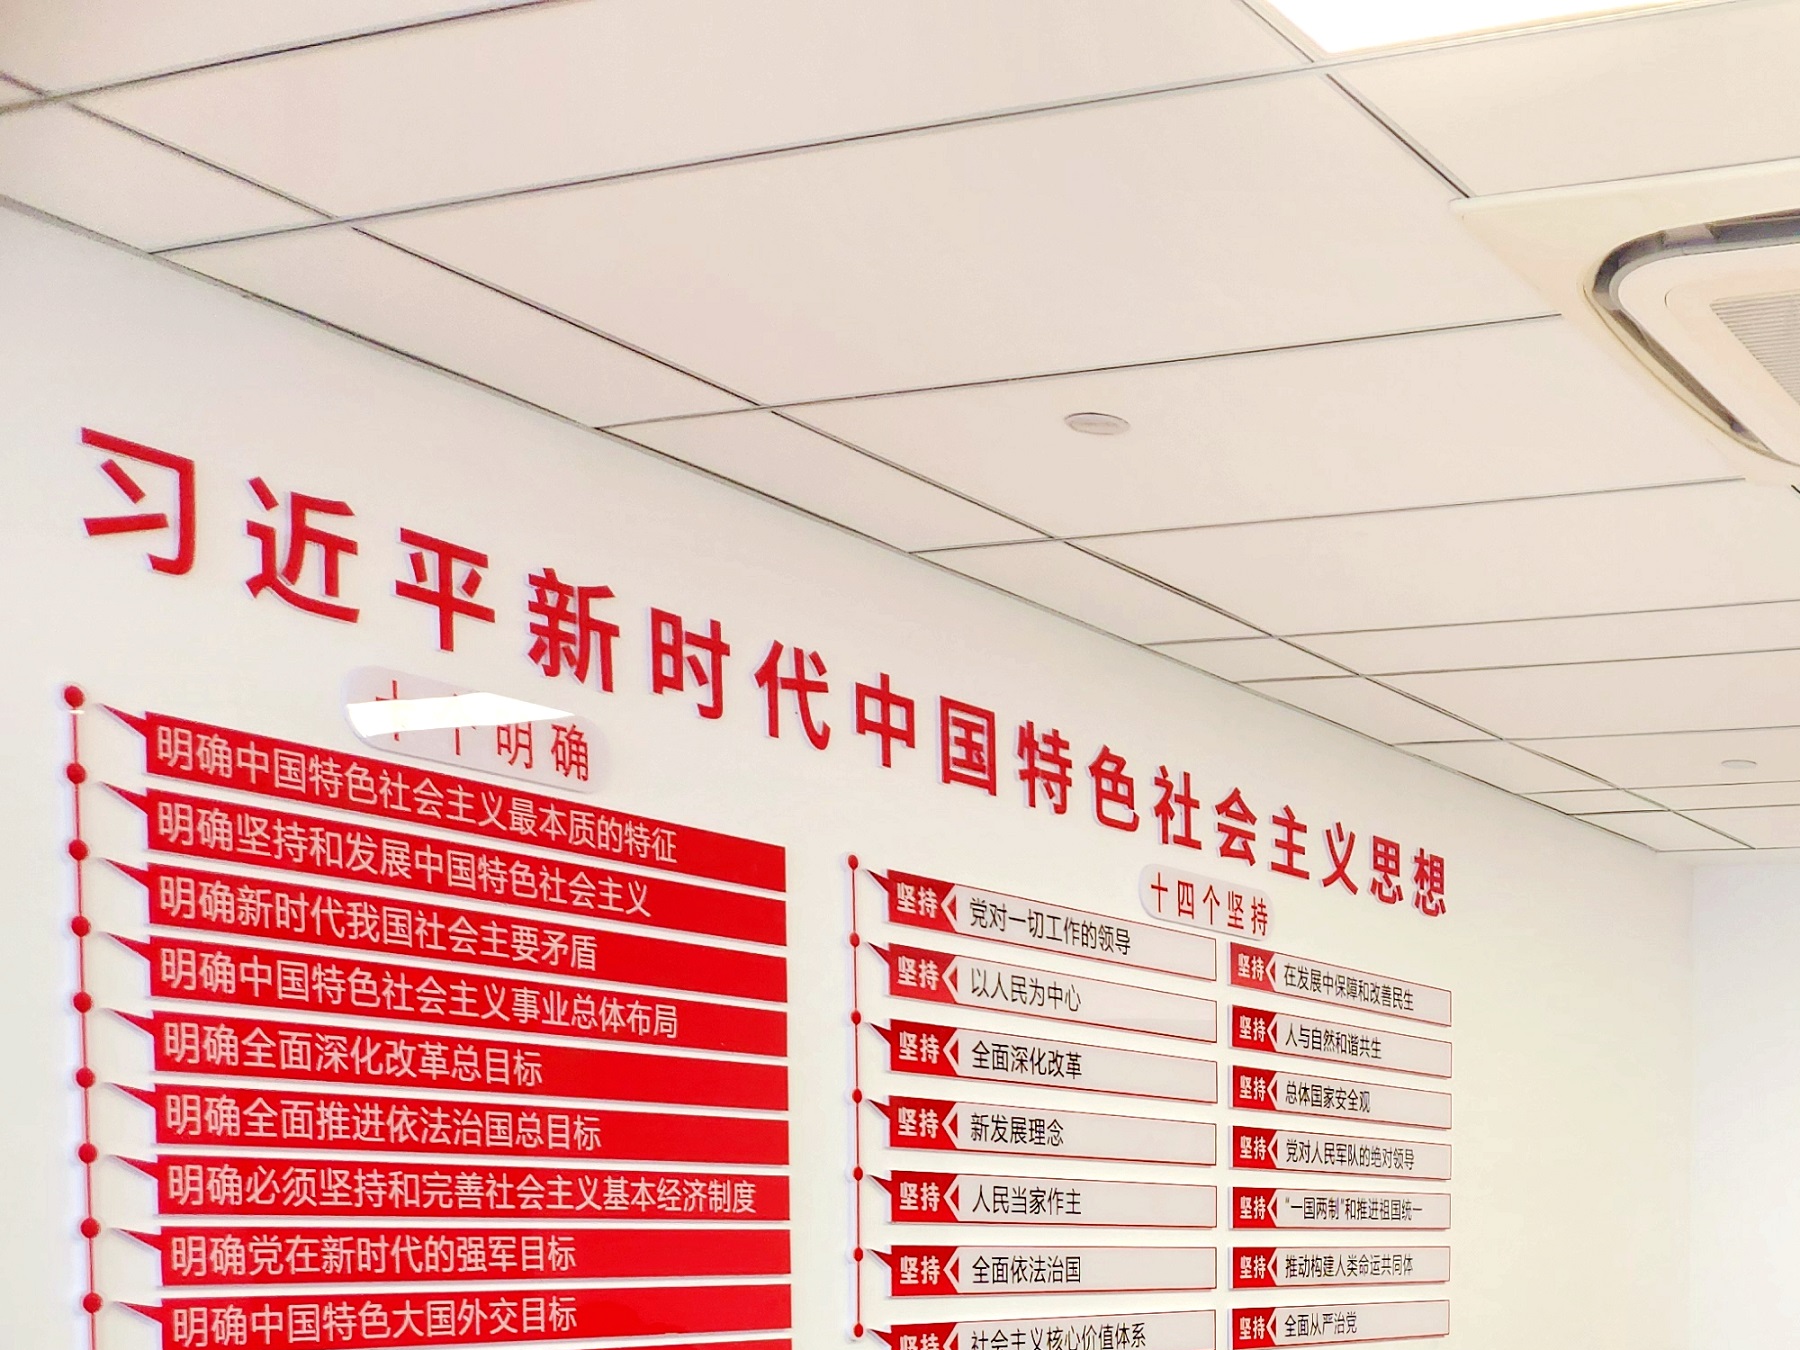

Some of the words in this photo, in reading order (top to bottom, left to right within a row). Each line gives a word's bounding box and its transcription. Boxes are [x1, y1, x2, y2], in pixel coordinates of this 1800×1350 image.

[80, 427, 1447, 917] 习近平新时代中国特色社会主义思想
[376, 680, 589, 782] 明确
[158, 726, 676, 862] 明确中国特色社会主义最本质的特征
[159, 802, 650, 917] 明确坚持和发展中国特色社会主义
[160, 876, 599, 974] 明确新时代我国社会主要矛盾
[897, 882, 938, 918] 坚持
[970, 897, 1131, 955] 党对一切工作的领导
[1151, 872, 1268, 937] 十四个坚持
[158, 949, 677, 1038] 明确中国特色社会主义事业总体布局
[898, 956, 940, 991] 坚持
[970, 967, 1081, 1012] 以人民为中心
[1238, 953, 1264, 981] 坚持
[1283, 962, 1414, 1011] 在发展中保障和改善民生
[165, 1023, 542, 1086] 明确全面深化改革总目标
[899, 1031, 940, 1065] 坚持
[972, 1040, 1082, 1079] 全面深化改革
[1239, 1015, 1266, 1042] 坚持
[1285, 1023, 1382, 1059] 人与自然和谐共生
[1239, 1075, 1266, 1101] 坚持
[1285, 1081, 1371, 1113] 总体国家安全观
[167, 1095, 601, 1150] 明确全面推进依法治国总目标
[898, 1107, 939, 1139] 坚持
[970, 1113, 1064, 1146] 新发展理念
[1240, 1136, 1266, 1160] 坚持
[1286, 1139, 1415, 1170] 党对人民军队的绝对领导
[169, 1164, 755, 1213] 明确必须坚持和完善社会主义基本经济制度
[899, 1181, 940, 1212] 坚持
[972, 1184, 1082, 1215] 人民当家作主
[1240, 1196, 1266, 1220] 坚持
[172, 1234, 575, 1276] 明确党在新时代的强军目标
[900, 1256, 940, 1285] 坚持
[972, 1256, 1081, 1284] 全面依法治国
[1240, 1255, 1266, 1280] 坚持
[1285, 1253, 1413, 1278] 推动构建人类命运共同体
[174, 1296, 576, 1346] 明确中国特色大国外交目标
[1239, 1316, 1265, 1340] 坚持
[1284, 1312, 1357, 1337] 全面从严治党
